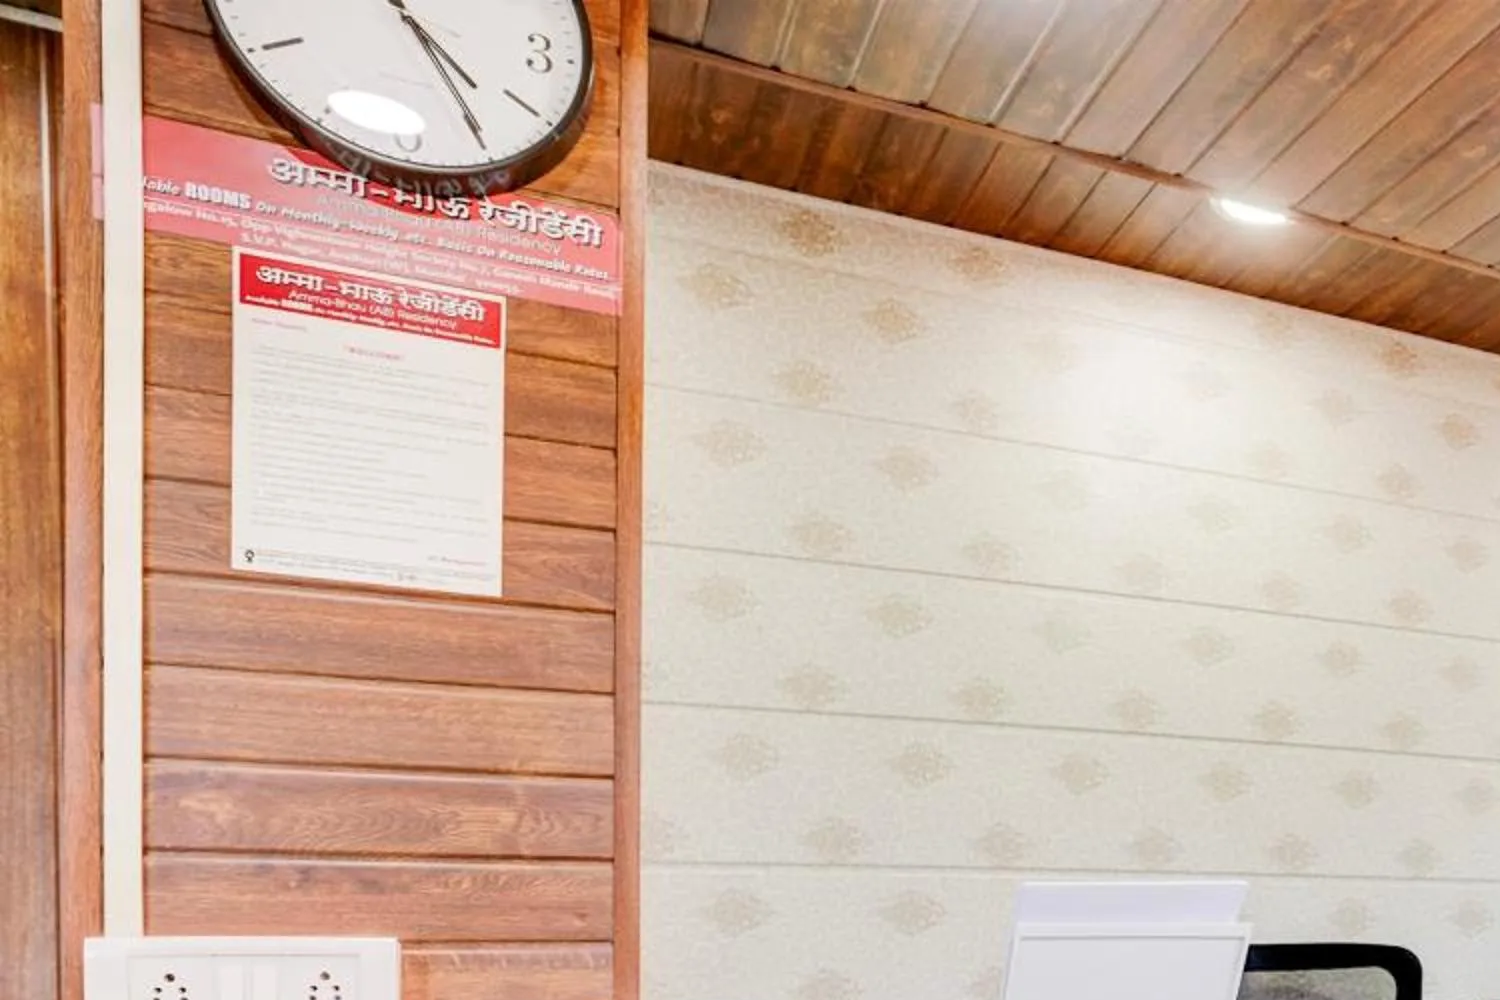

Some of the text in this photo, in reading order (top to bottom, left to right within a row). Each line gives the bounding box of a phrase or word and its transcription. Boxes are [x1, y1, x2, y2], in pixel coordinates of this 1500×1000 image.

[527, 33, 552, 73] 3
[184, 181, 253, 210] ROOMS
[479, 225, 562, 256] Residency
